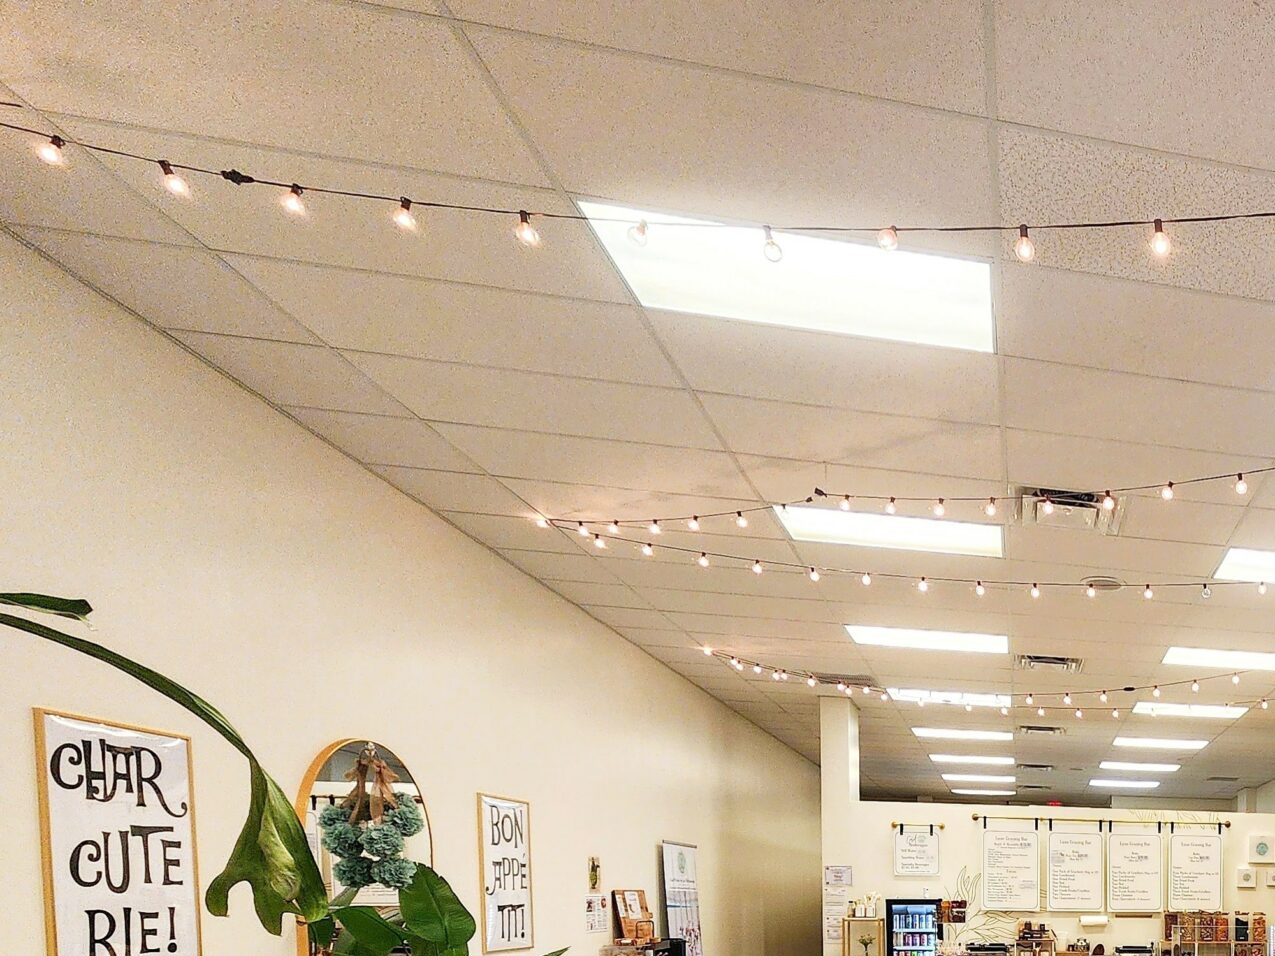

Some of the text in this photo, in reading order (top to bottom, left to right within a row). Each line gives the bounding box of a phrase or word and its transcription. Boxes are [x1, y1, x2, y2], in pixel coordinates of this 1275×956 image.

[50, 738, 187, 818] CHAR
[490, 805, 524, 848] BON
[69, 825, 183, 893] CUTE
[485, 853, 528, 895] APPÉ
[497, 904, 525, 942] TIT!
